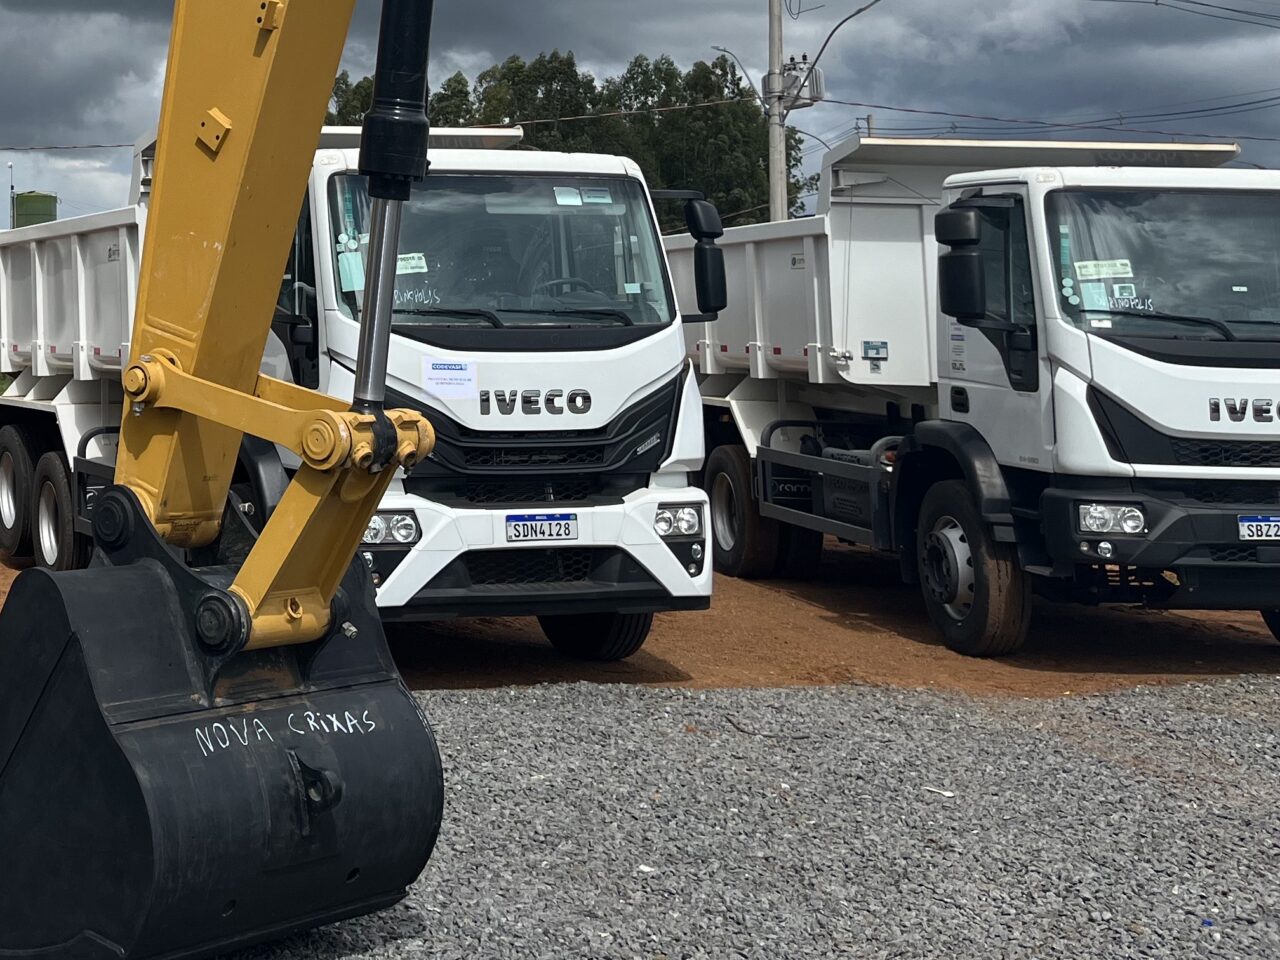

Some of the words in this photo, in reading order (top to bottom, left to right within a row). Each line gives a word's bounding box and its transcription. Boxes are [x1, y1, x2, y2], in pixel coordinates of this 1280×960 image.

[480, 389, 592, 415] IVECO
[1209, 398, 1280, 422] IVE
[195, 718, 274, 757] NOVA
